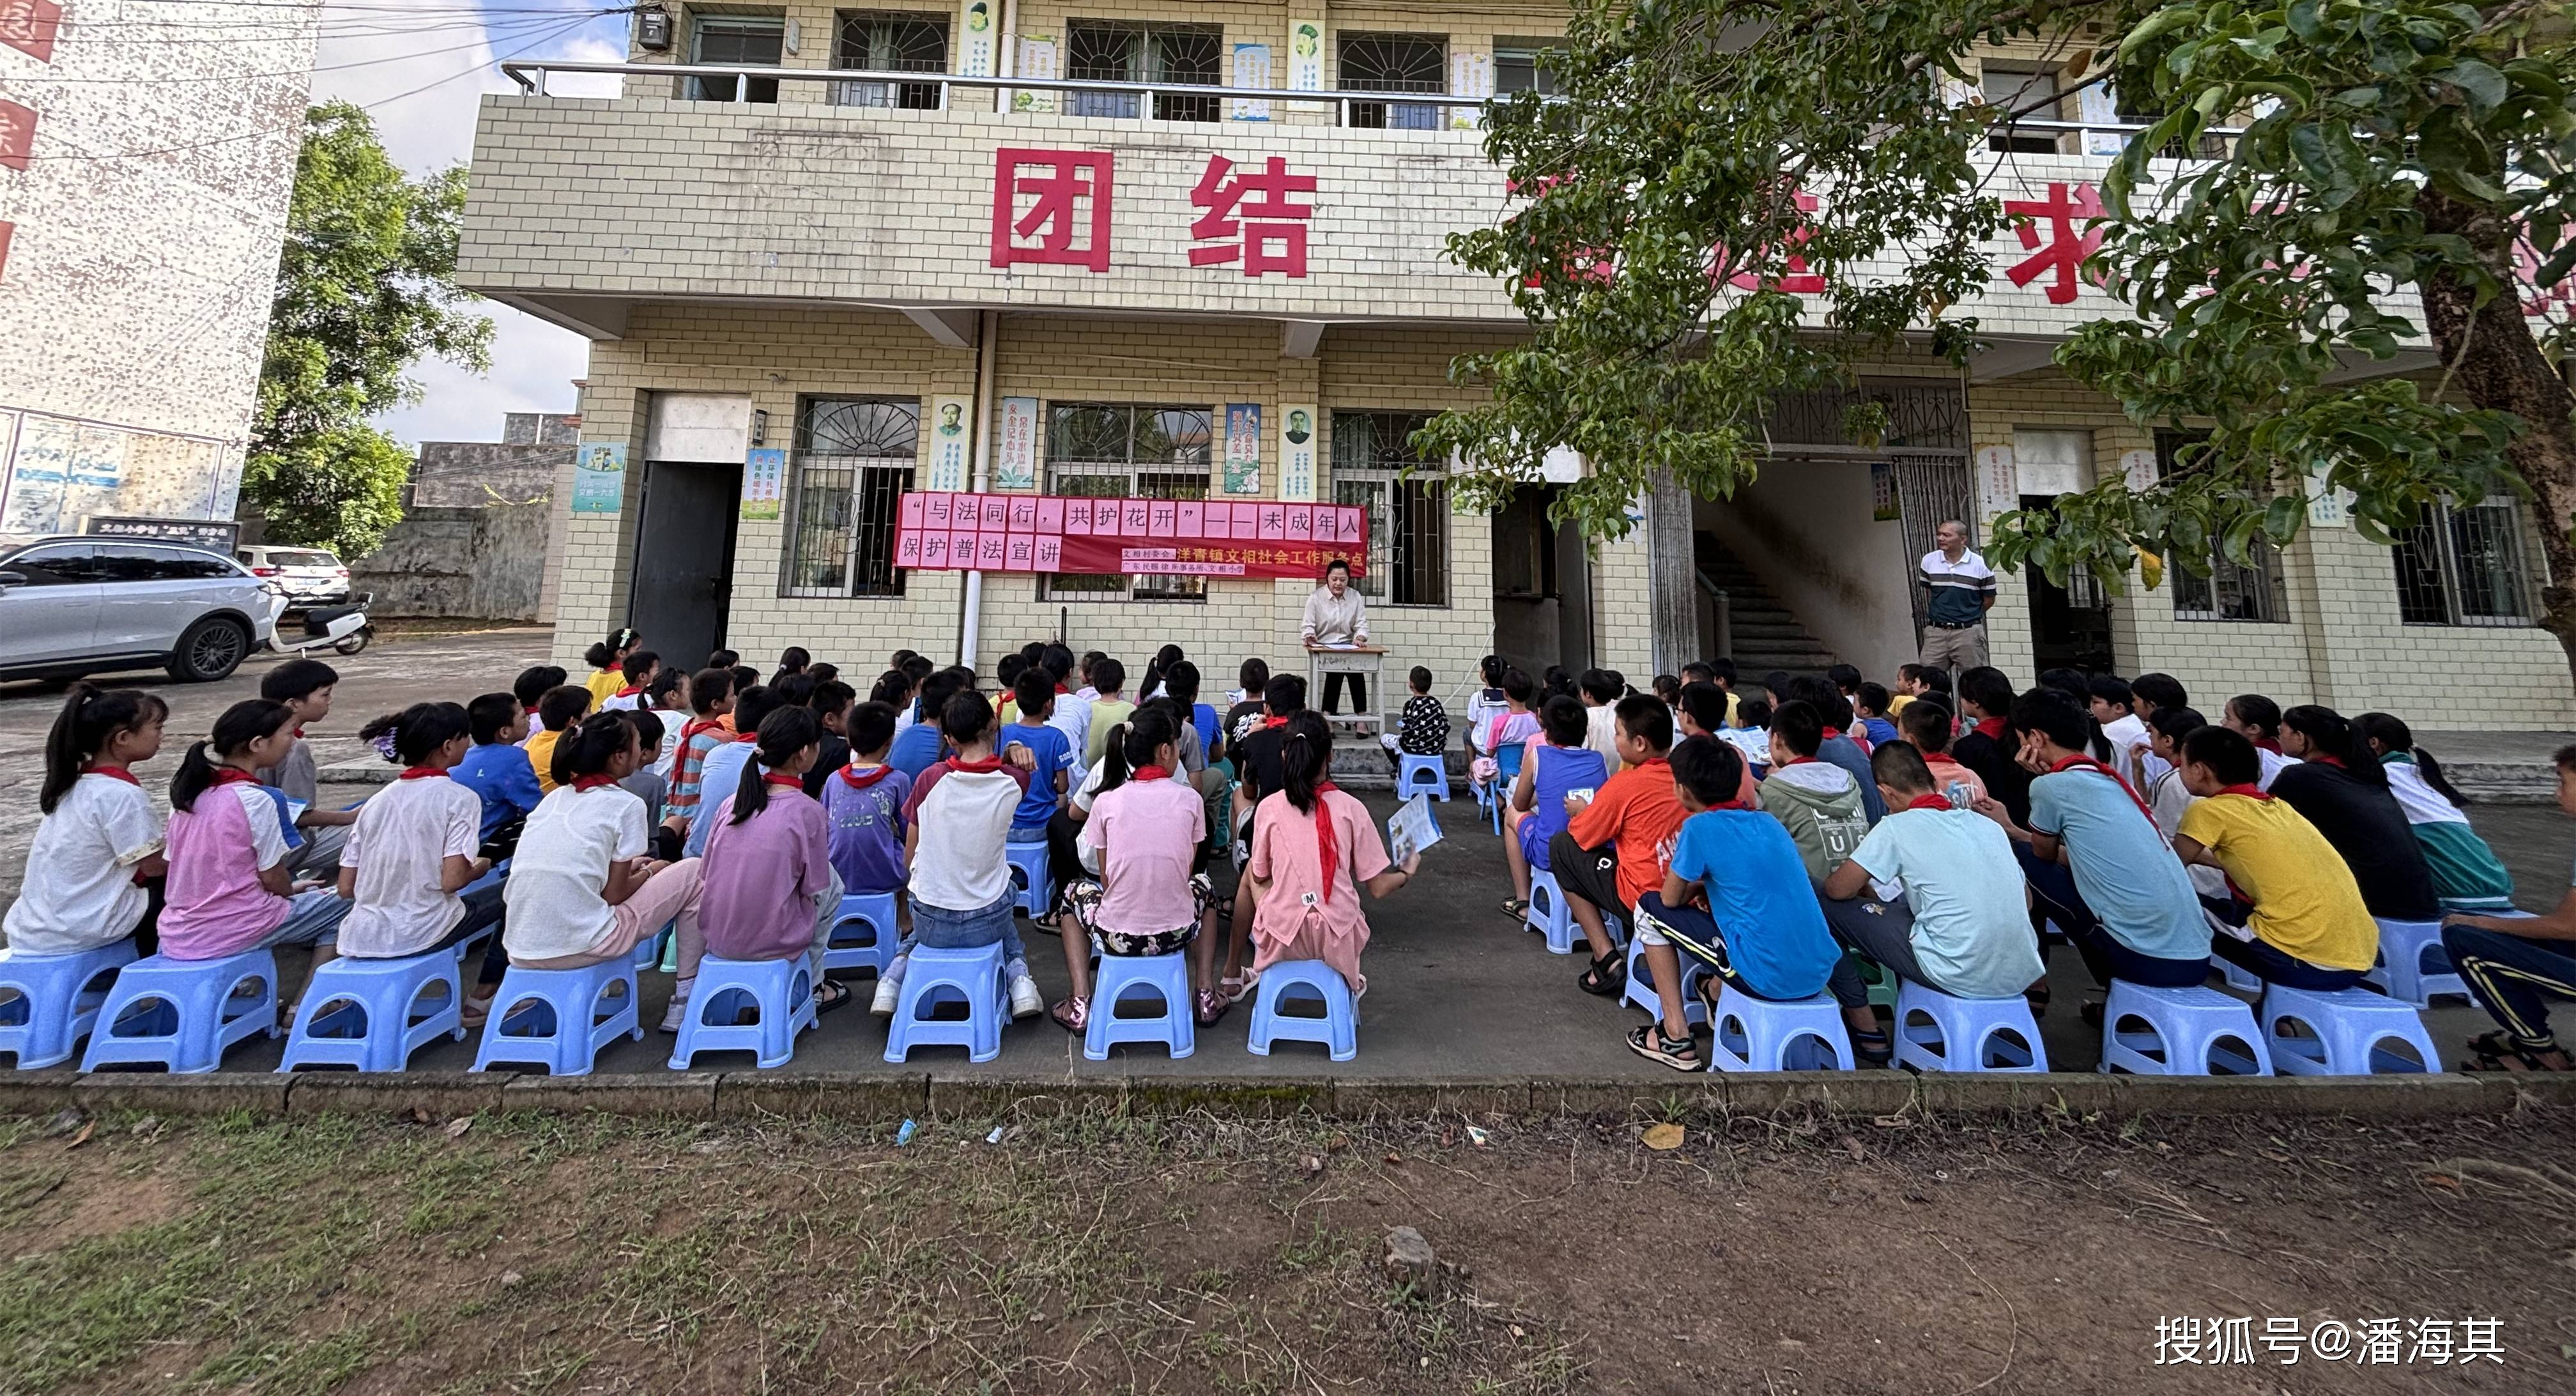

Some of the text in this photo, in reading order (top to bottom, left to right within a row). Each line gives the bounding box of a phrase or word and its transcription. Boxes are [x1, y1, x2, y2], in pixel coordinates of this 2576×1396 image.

[990, 148, 1317, 278] 团结
[1005, 403, 1018, 464] 安全记心头
[902, 536, 1059, 564] 保护普法宣讲
[1176, 547, 1364, 567] 洋青镇文相社会工作服务点
[1830, 835, 1846, 853] U
